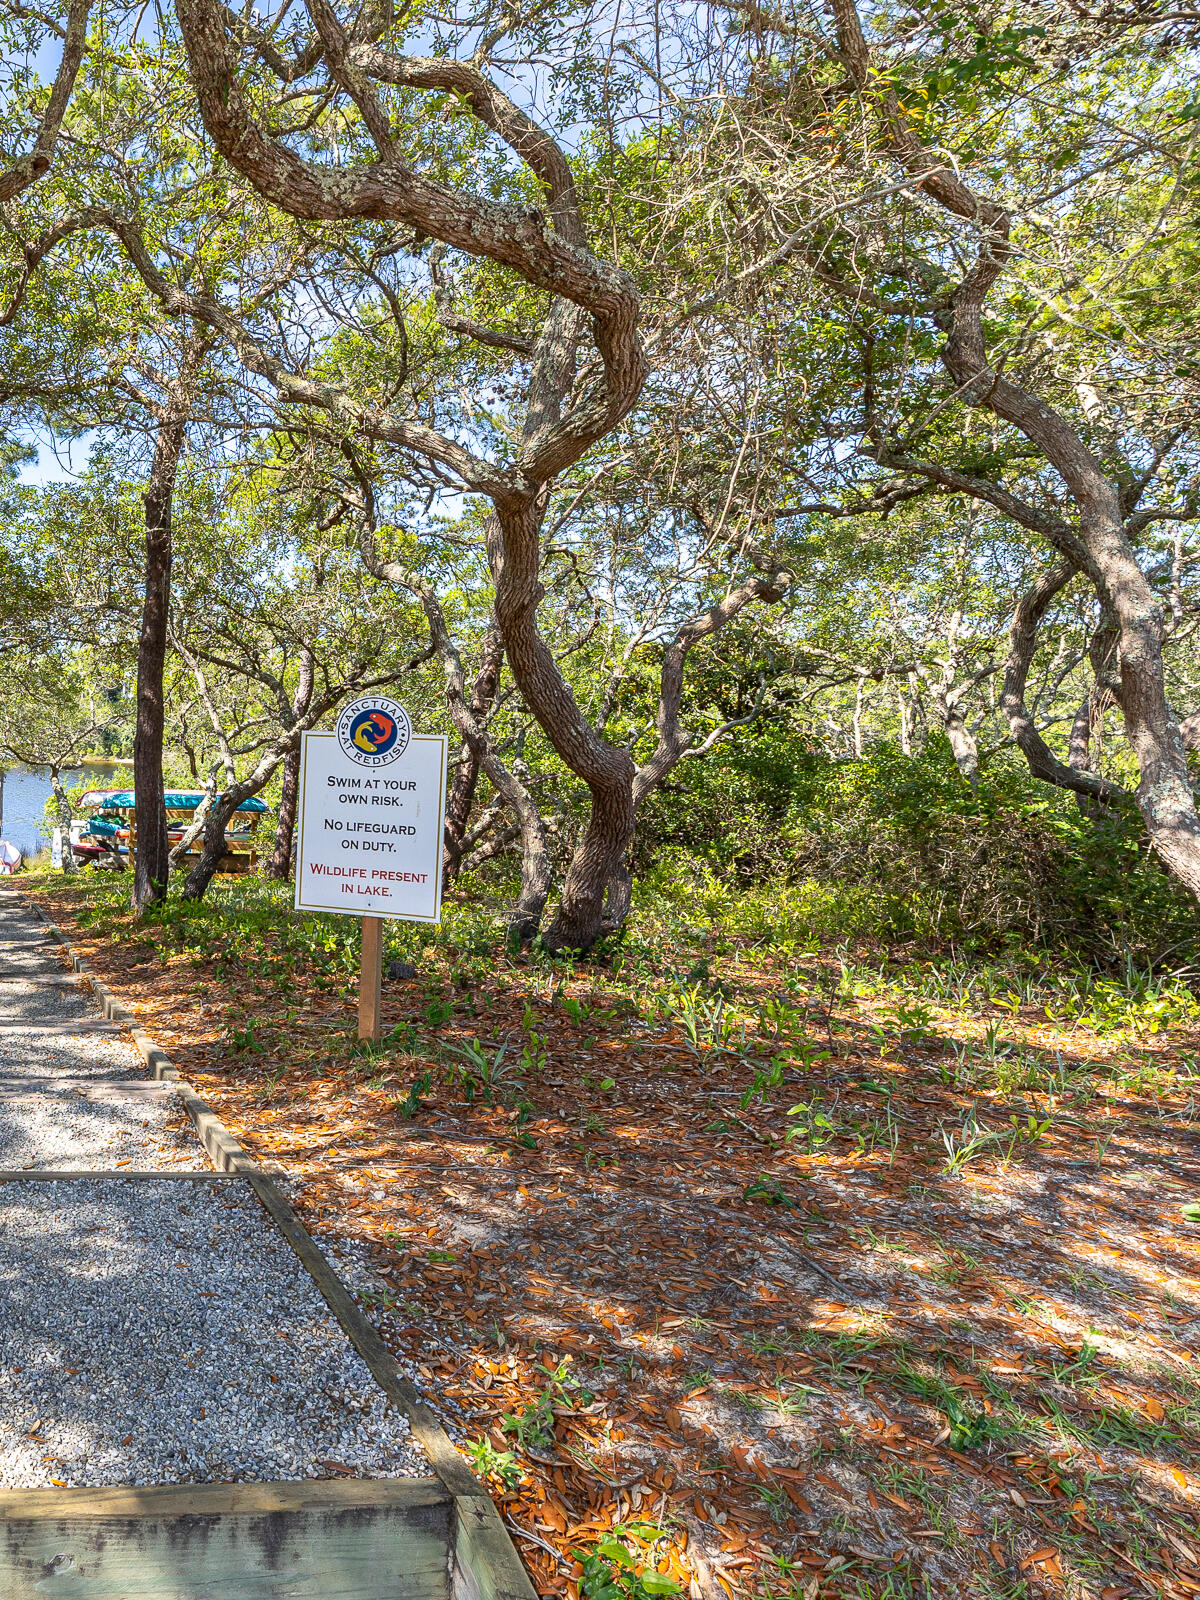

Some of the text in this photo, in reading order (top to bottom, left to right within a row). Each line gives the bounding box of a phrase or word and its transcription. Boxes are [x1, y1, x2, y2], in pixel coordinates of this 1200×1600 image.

[341, 701, 406, 729] SANCTUARY
[342, 738, 406, 764] AT REDFISH
[328, 776, 416, 791] SWIM AT YOUR
[339, 794, 403, 806] OWN RISK.
[324, 819, 416, 835] NO LIFEGUARD
[341, 840, 396, 852] ON DUTY.
[310, 863, 428, 883] WILDLIFE PRESENT
[342, 884, 392, 896] IN LAKE.
